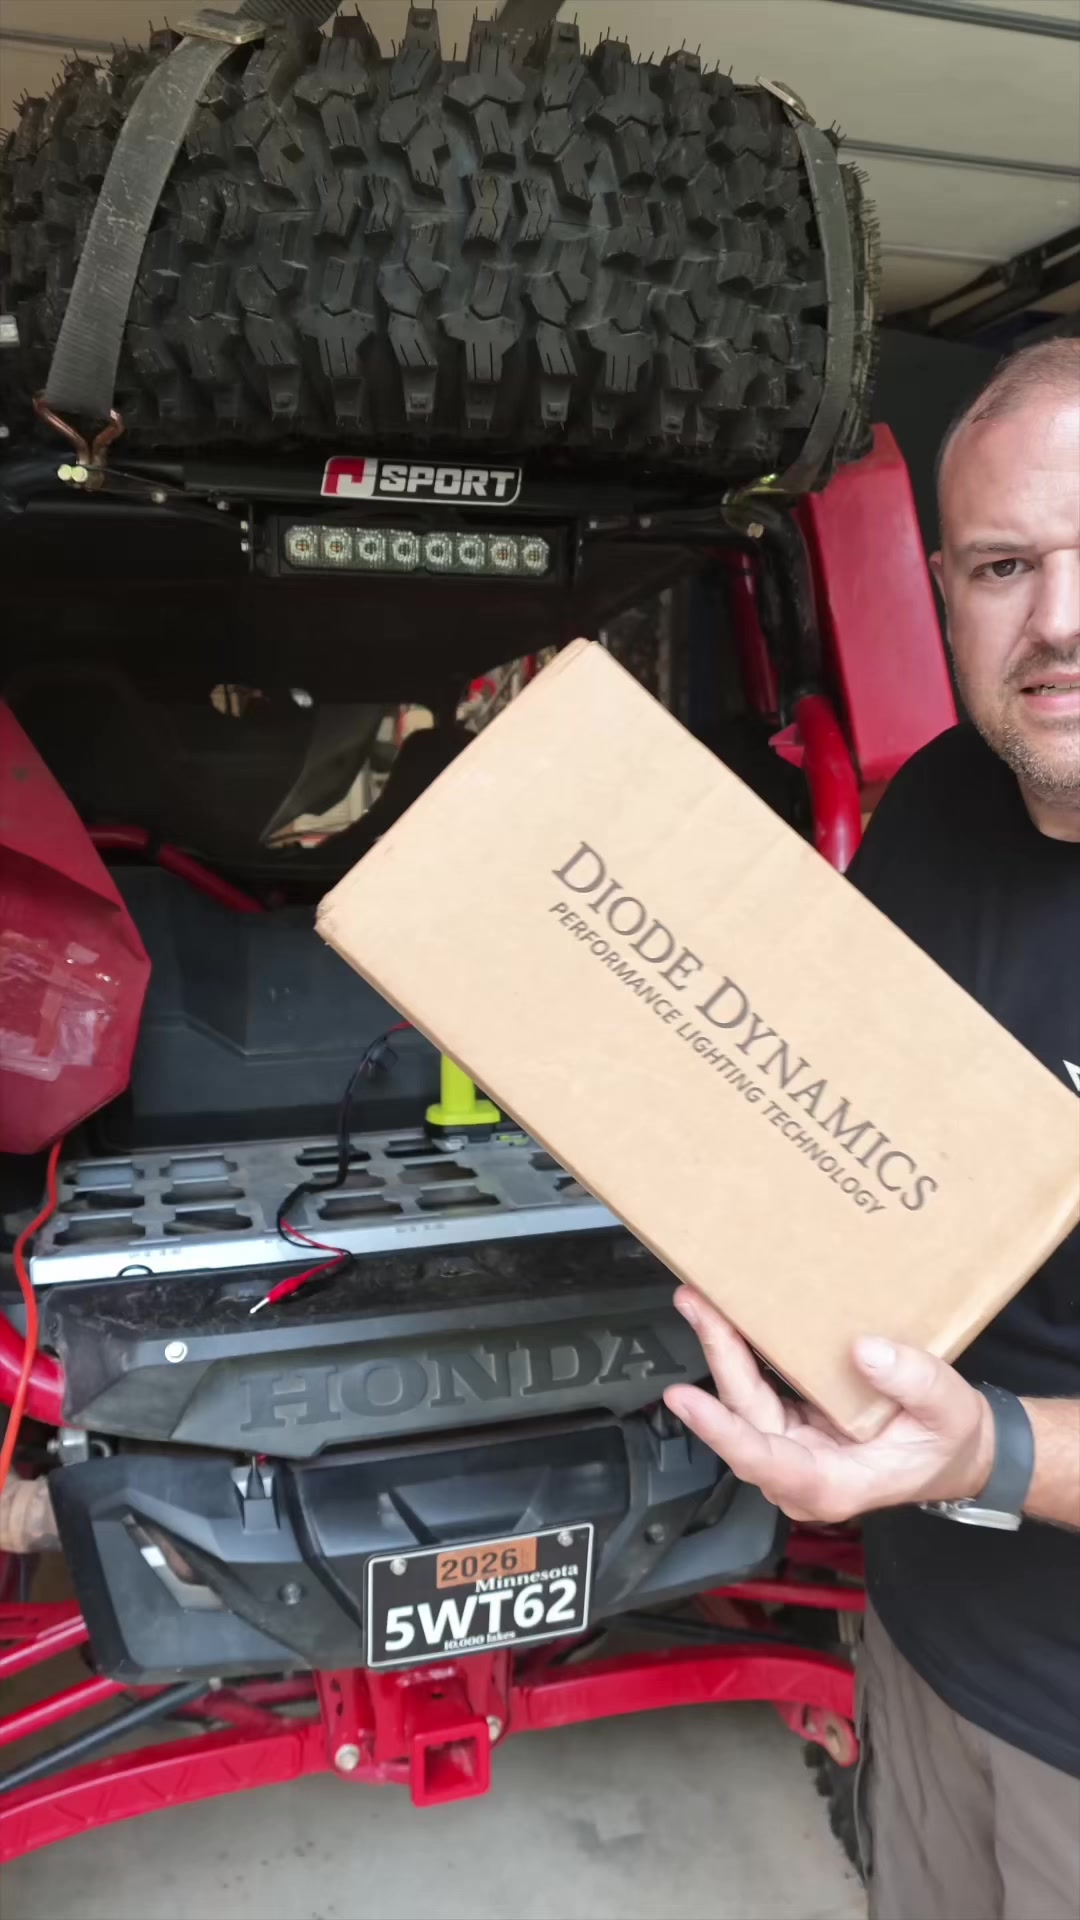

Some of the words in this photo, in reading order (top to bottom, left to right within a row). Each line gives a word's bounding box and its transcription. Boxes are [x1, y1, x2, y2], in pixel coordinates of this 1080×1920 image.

[379, 464, 515, 497] SPORT
[548, 901, 683, 1025] PERFORMANCE
[676, 1021, 764, 1104] LIGHTING
[760, 1100, 886, 1215] TECHNOLOGY
[551, 841, 704, 991] DIODE
[695, 975, 938, 1211] DYNAMICS
[240, 1325, 687, 1431] HONDA
[440, 1548, 518, 1582] 2026
[475, 1564, 579, 1593] Minnesota
[384, 1577, 578, 1652] 5WT62
